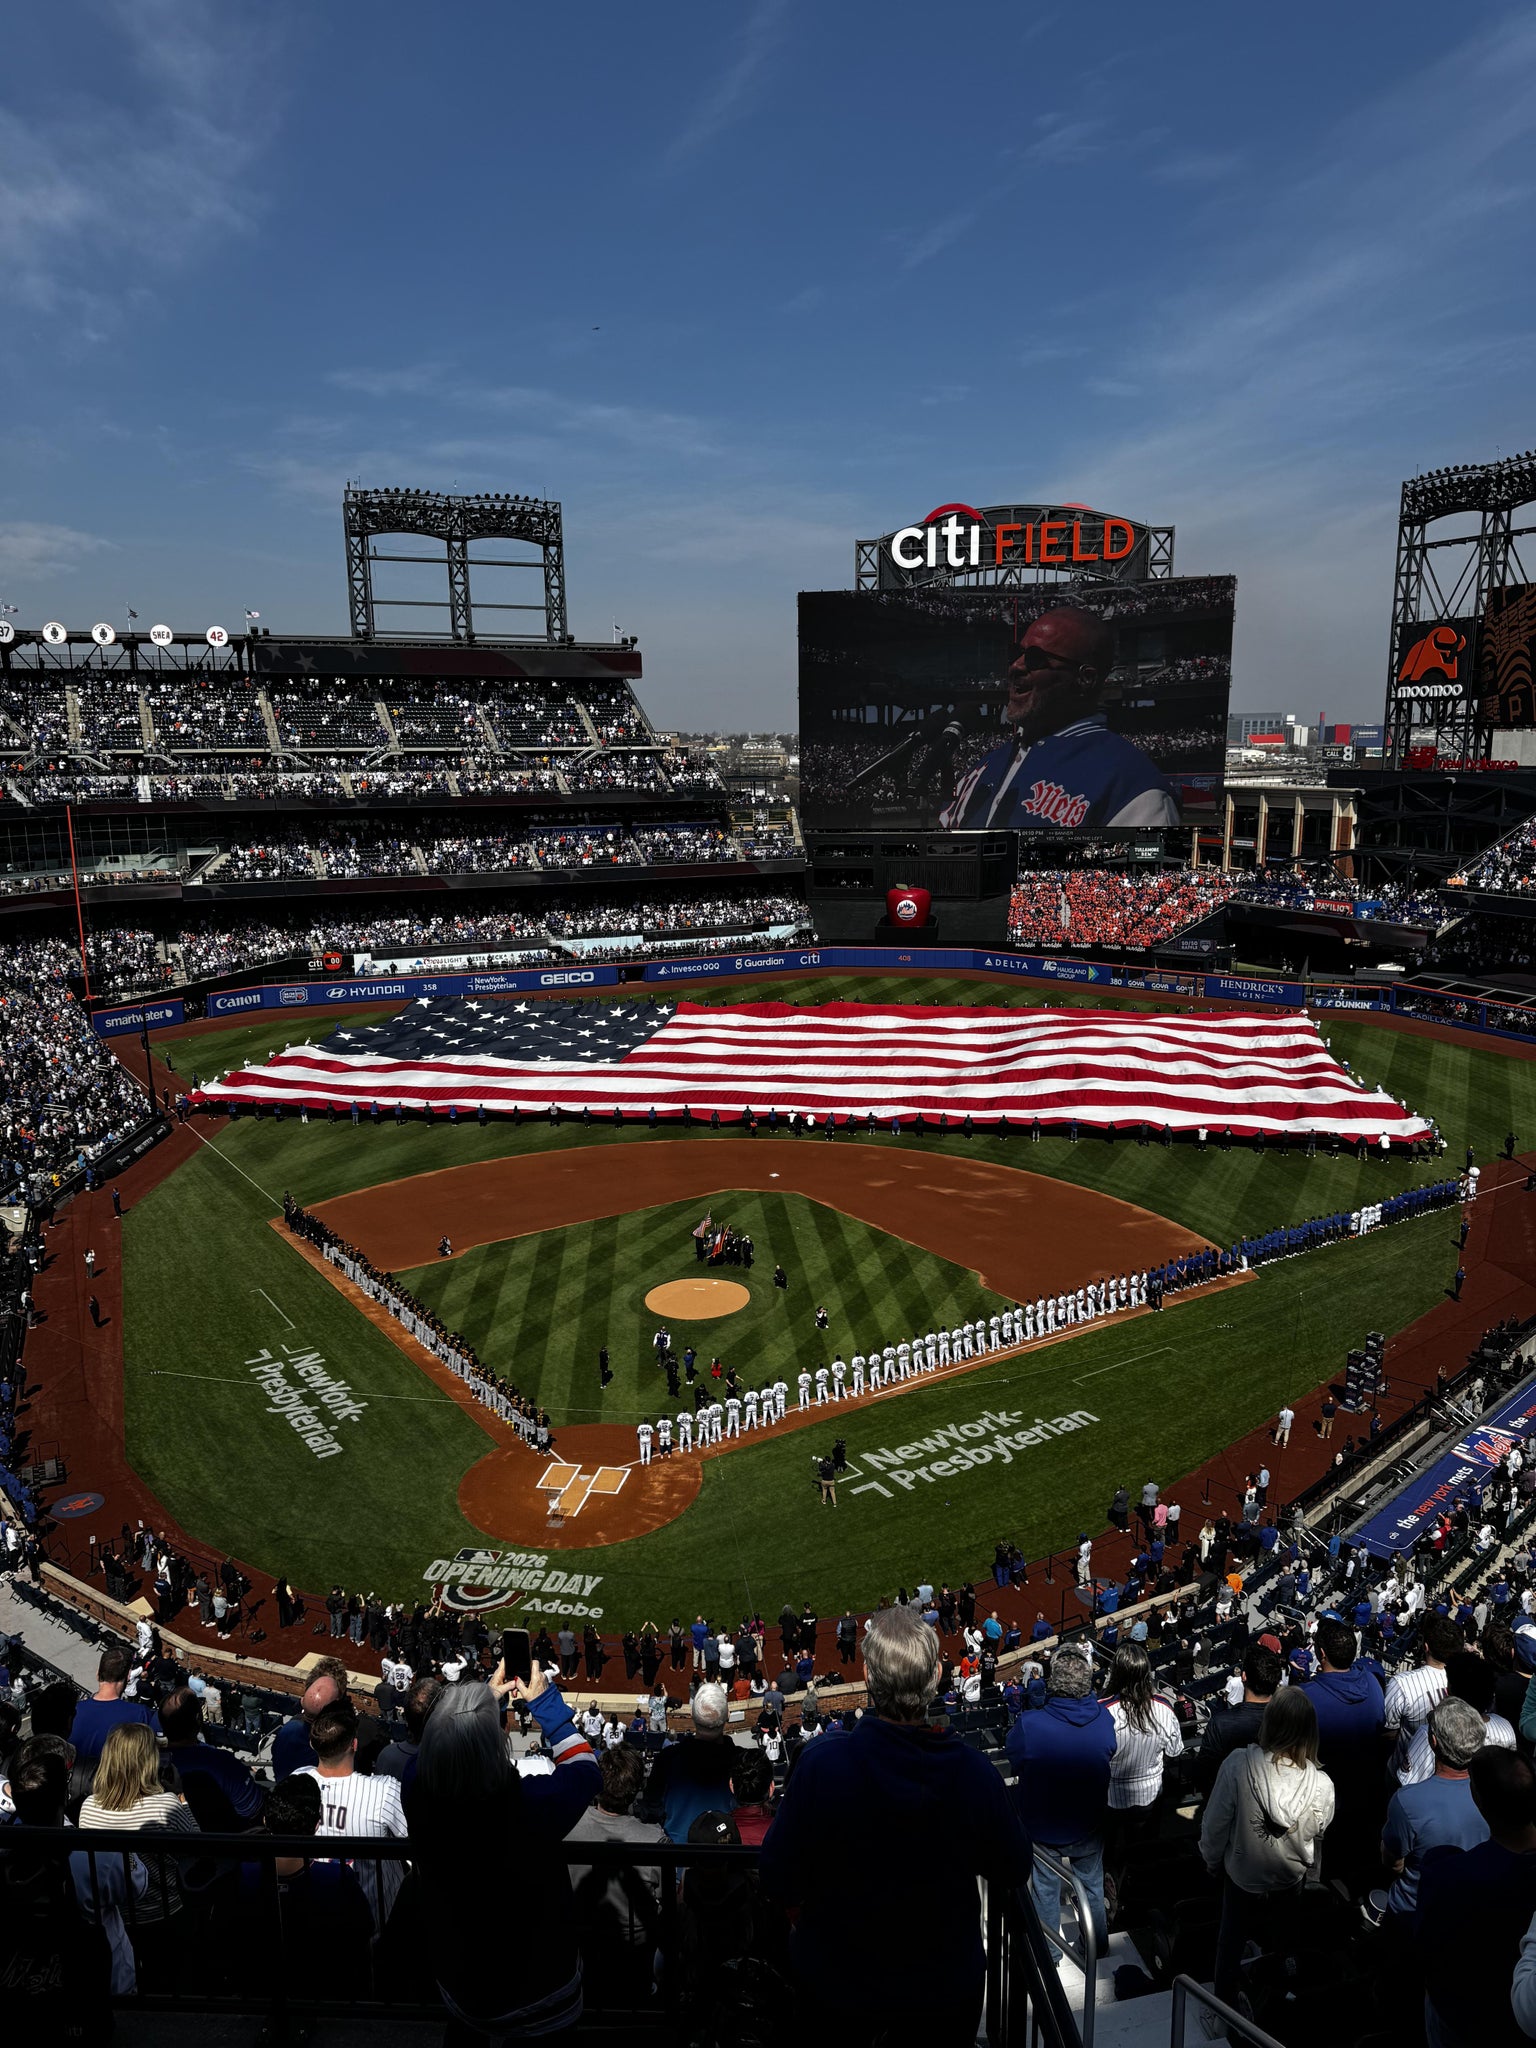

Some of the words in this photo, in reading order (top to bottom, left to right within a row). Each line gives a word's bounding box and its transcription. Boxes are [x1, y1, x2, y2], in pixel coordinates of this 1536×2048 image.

[891, 514, 980, 568] citi
[995, 519, 1135, 564] FIELD
[152, 631, 170, 640] SHEA
[210, 631, 223, 641] 42
[1397, 684, 1463, 698] moomoo
[1343, 746, 1353, 761] 8
[308, 958, 323, 968] citi
[331, 957, 340, 965] 00
[744, 957, 784, 968] Guardian
[800, 953, 820, 965] citi
[995, 958, 1028, 970] DELTA
[671, 965, 702, 974] Invesco
[703, 962, 720, 972] QQQ
[541, 971, 594, 985] GEICO
[1057, 972, 1075, 980] GROUP
[1110, 978, 1122, 986] 380
[350, 984, 405, 997] HYUNDAI
[423, 984, 437, 992] 358
[475, 982, 517, 991] Presbyterian
[1220, 979, 1284, 994] HENDRICK'S
[216, 993, 261, 1010] Canon
[1335, 1000, 1372, 1010] DUNKIN'
[1380, 1003, 1390, 1011] 370
[105, 1010, 164, 1028] smartwater
[1410, 1011, 1453, 1026] CADILLAC
[250, 1362, 344, 1459] Presbyterian
[1508, 1416, 1529, 1429] the
[886, 1409, 1100, 1490] Presbyterian
[1396, 1514, 1420, 1529] the
[1414, 1499, 1437, 1517] new
[1431, 1483, 1455, 1502] york
[1447, 1465, 1474, 1486] mets
[500, 1552, 549, 1568] 2026
[422, 1559, 546, 1591] OPENING
[540, 1571, 604, 1597] DAY
[520, 1597, 604, 1619] Adobe
[395, 1672, 405, 1680] 28
[769, 1741, 778, 1750] 10
